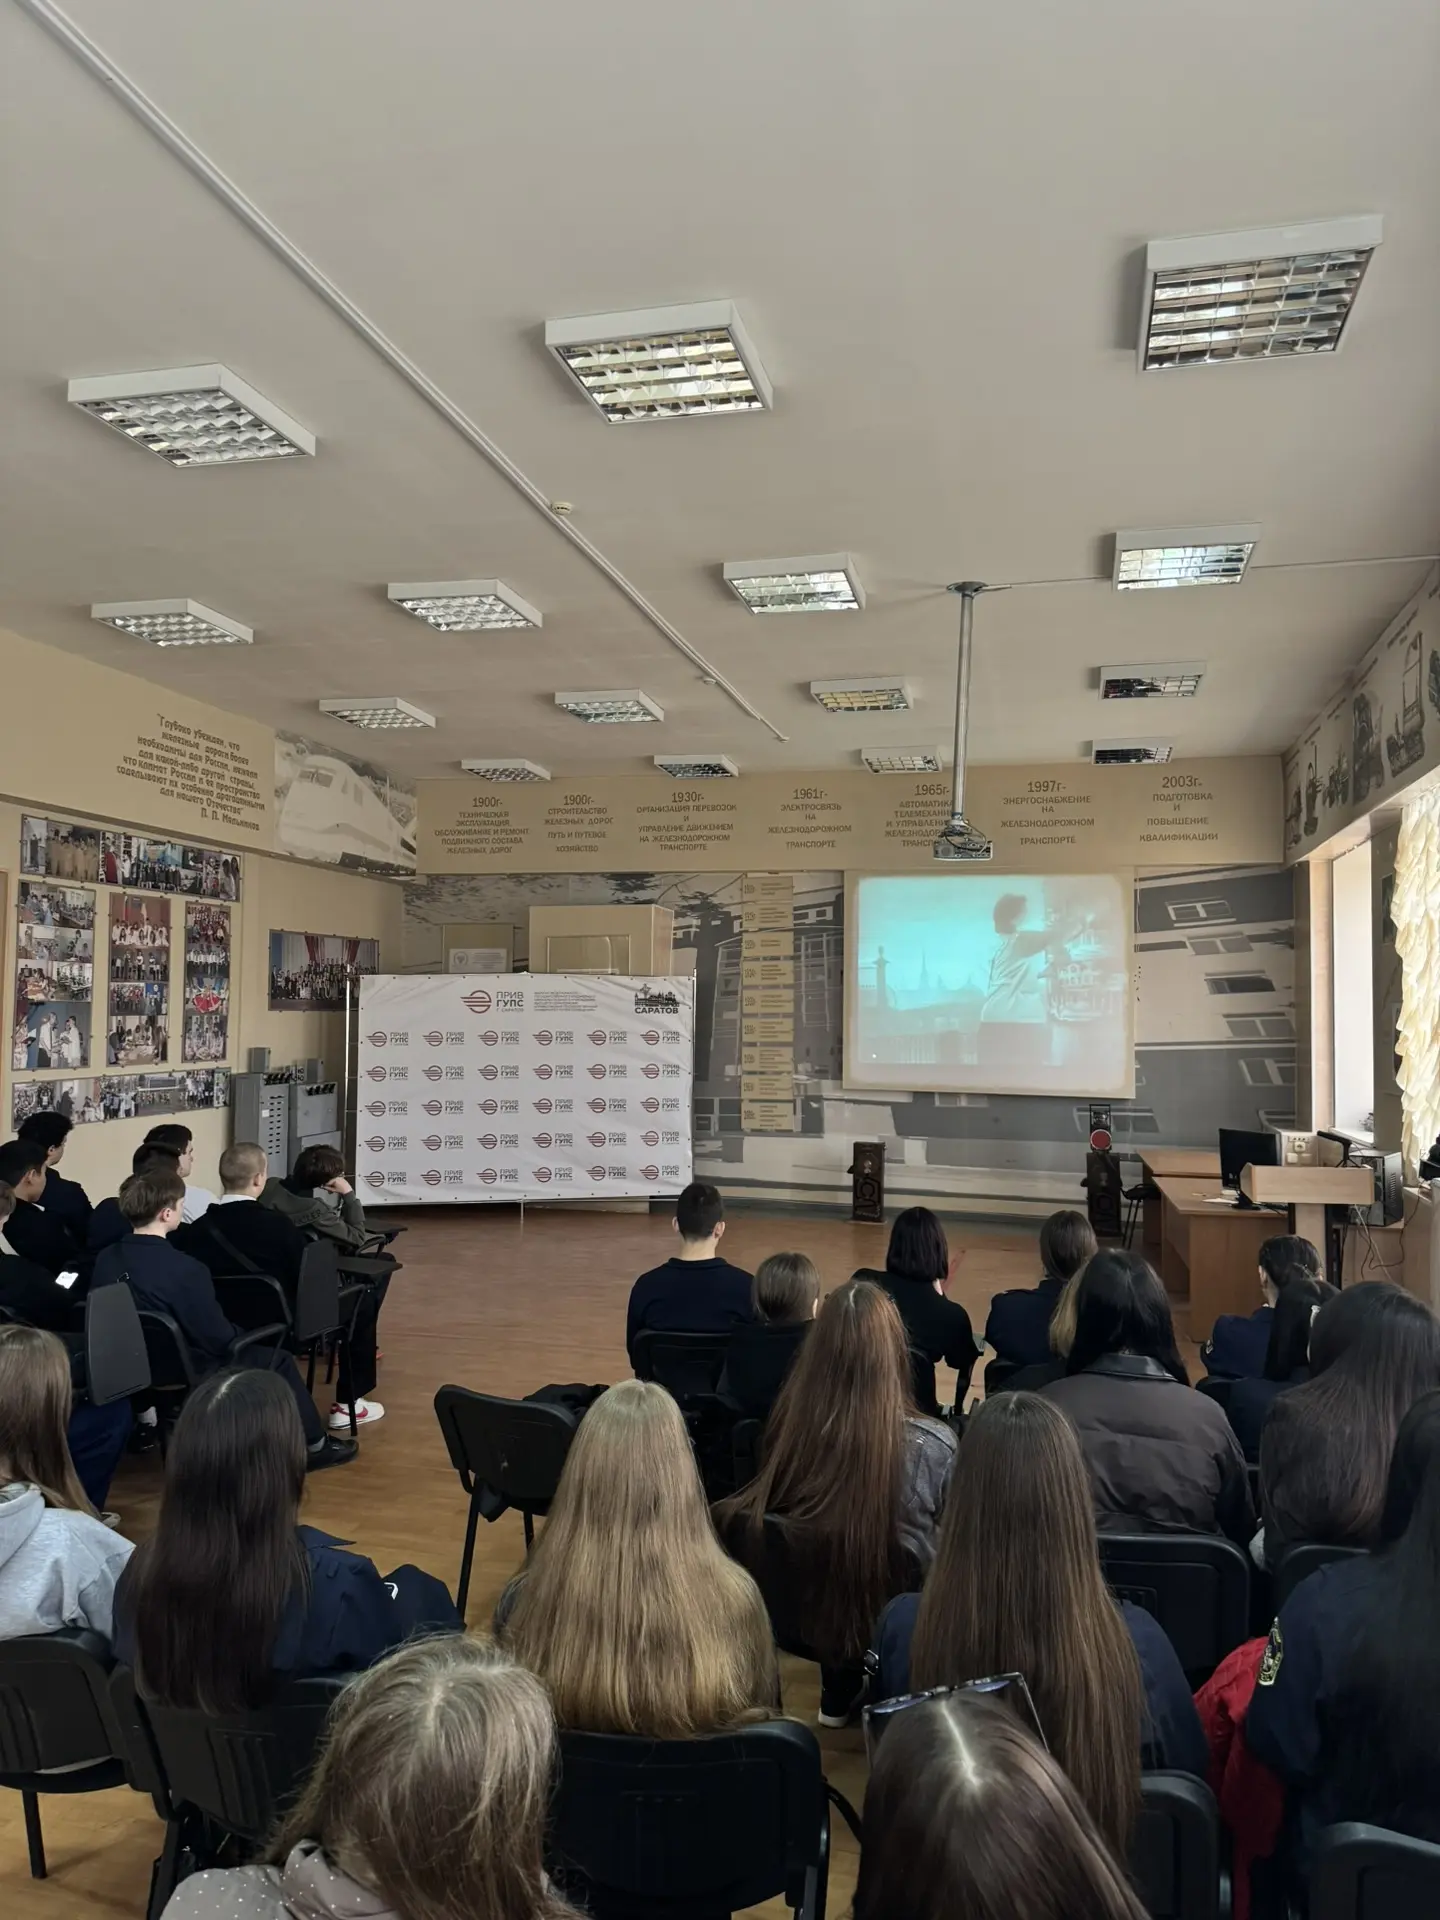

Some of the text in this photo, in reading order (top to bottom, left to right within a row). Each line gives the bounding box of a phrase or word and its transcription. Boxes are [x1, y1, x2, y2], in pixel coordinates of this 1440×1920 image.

[1002, 795, 1092, 805] ЭНЕРГОСНАБЖЕНИЕ
[1152, 793, 1213, 802] ПОДГОТОВКА
[1041, 805, 1055, 813] НА
[1173, 803, 1181, 812] И
[805, 813, 817, 821] НА
[1146, 817, 1209, 826] ПОВЫШЕНИЕ
[1000, 818, 1095, 828] ЖЕЛЕЗНОДОРОЖНОМ
[1019, 835, 1077, 845] ТРАНСПОРТЕ
[1139, 833, 1219, 842] КВАЛИФИКАЦИИ
[496, 991, 524, 999] ПРИВ
[496, 999, 524, 1007] ГУПС
[390, 1036, 409, 1044] ГУПС
